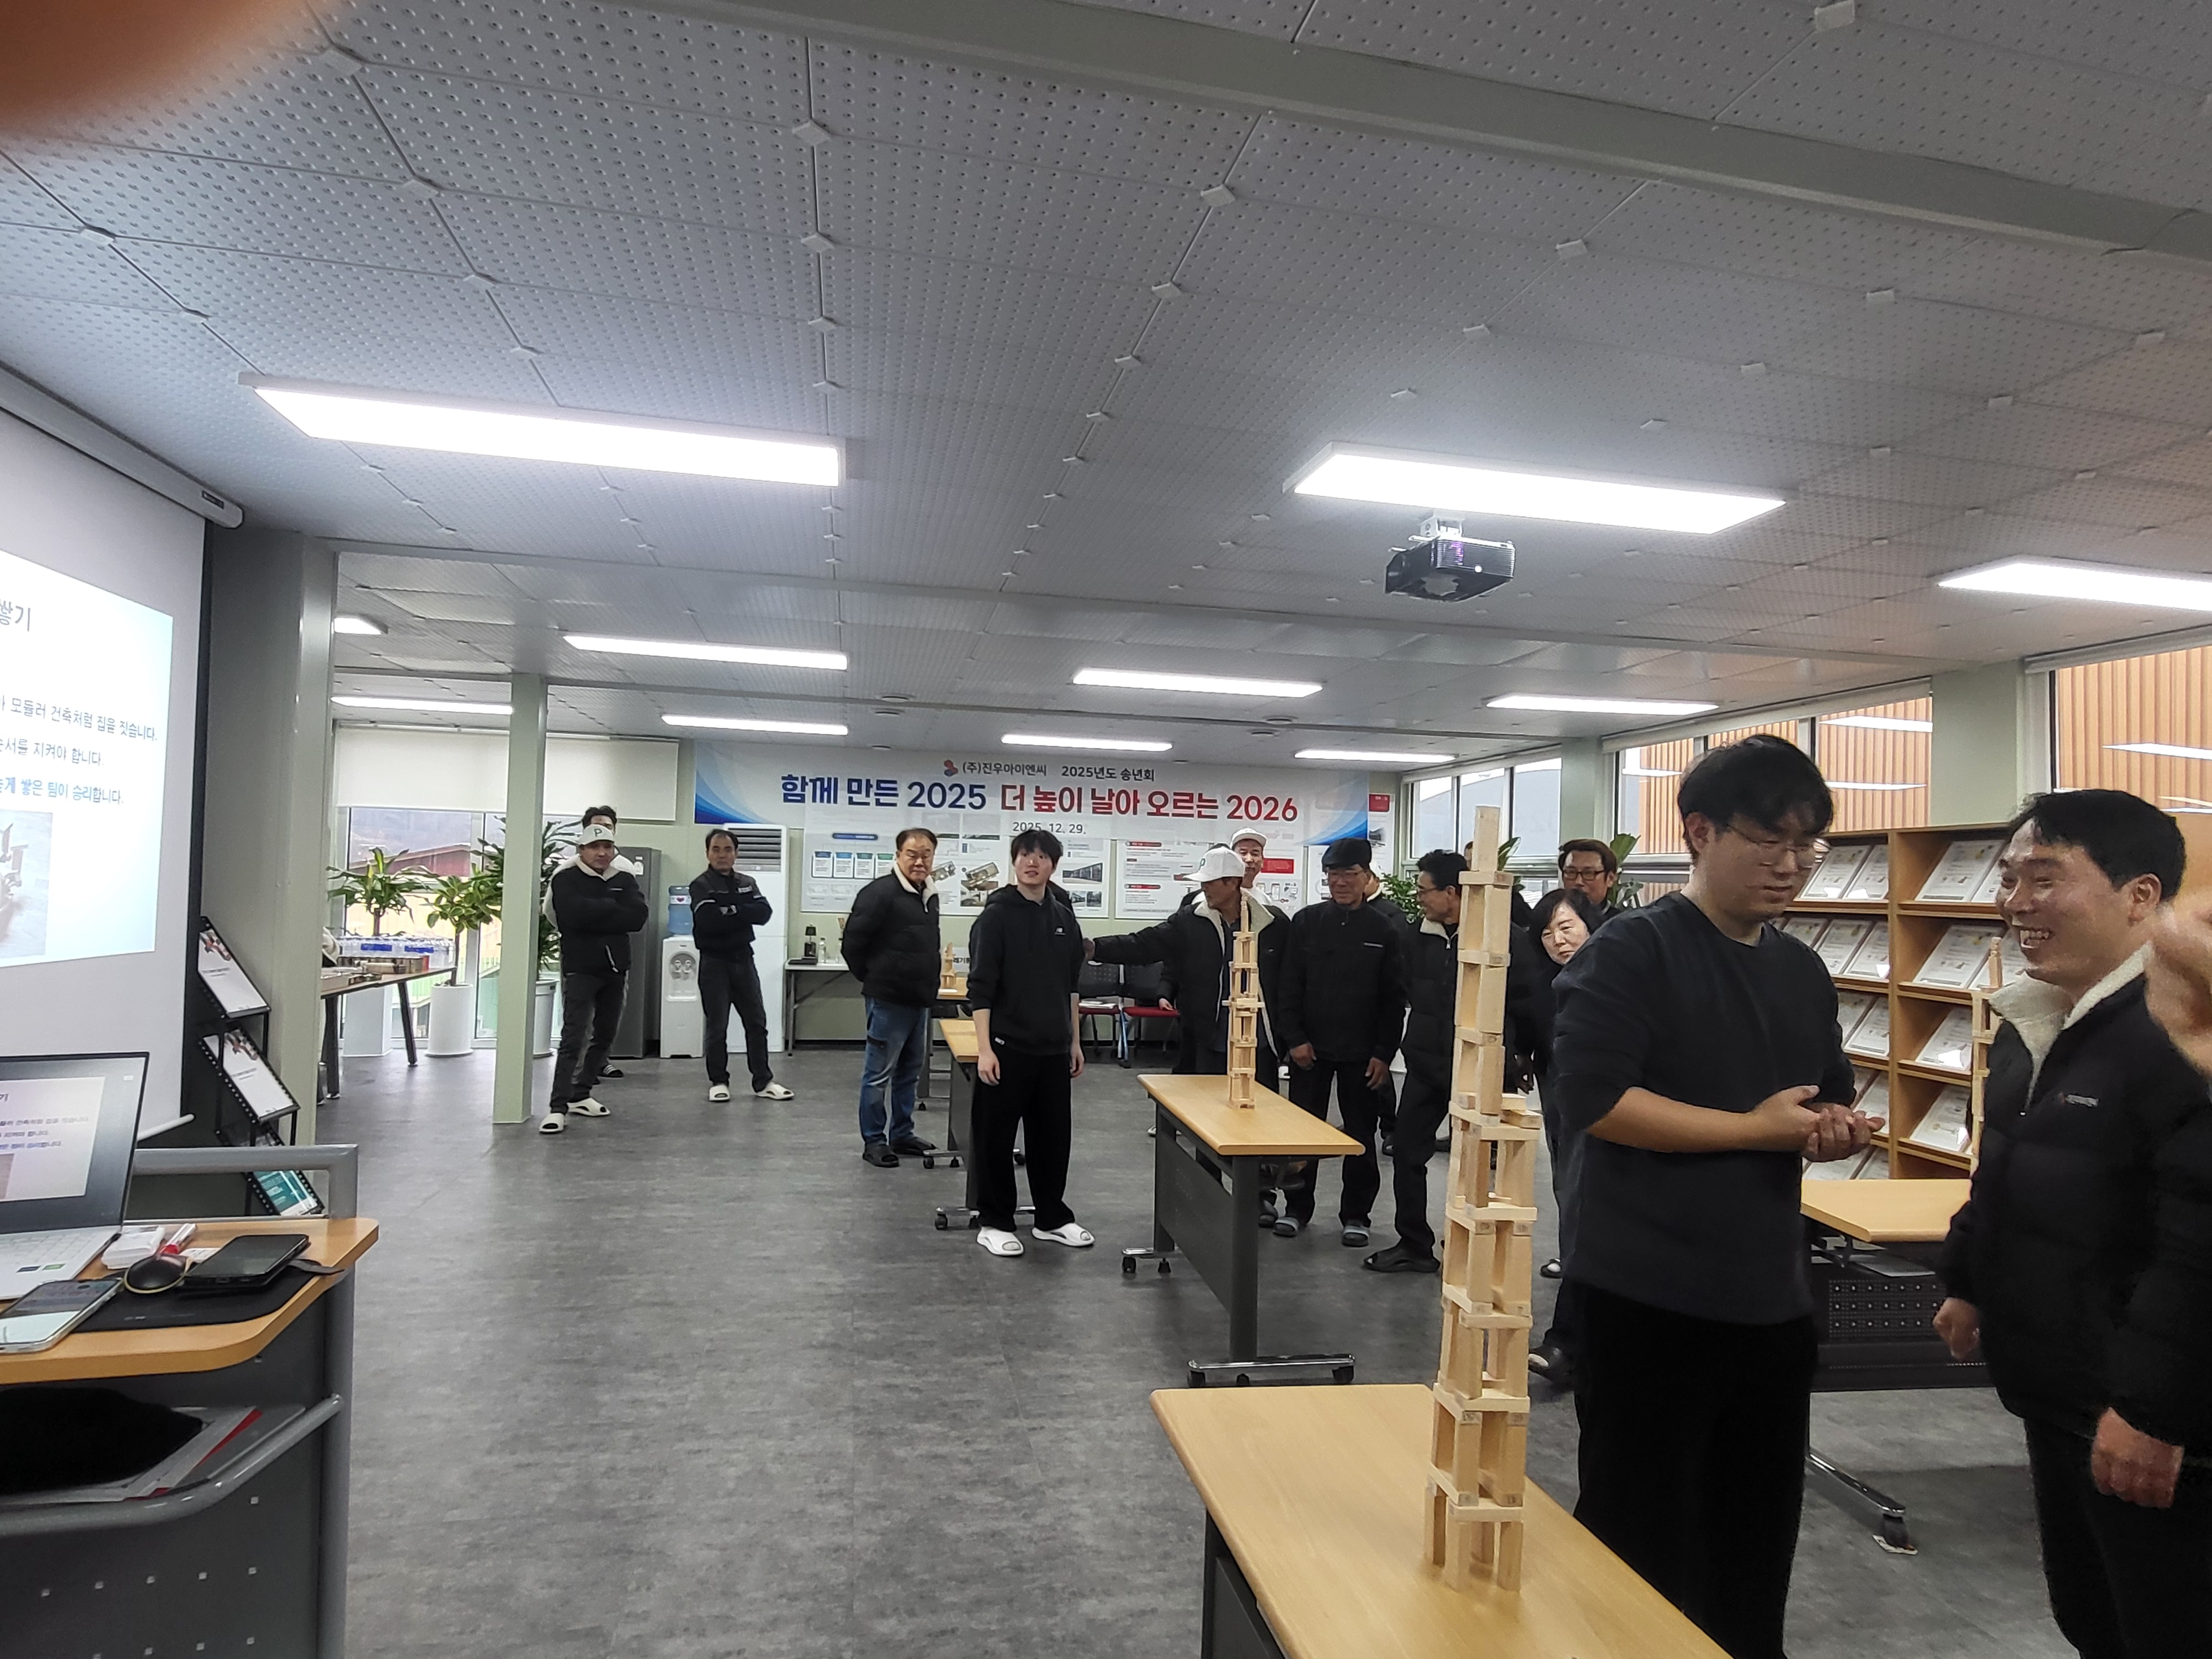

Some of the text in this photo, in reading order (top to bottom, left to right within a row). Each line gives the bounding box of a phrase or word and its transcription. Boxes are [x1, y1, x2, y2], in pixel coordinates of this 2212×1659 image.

[11, 697, 45, 719] 모듈러
[51, 706, 92, 728] 건축처럼
[97, 716, 116, 734] 집을
[119, 721, 157, 741] 짓습니다.
[33, 742, 66, 761] 지켜야
[72, 748, 104, 766] 합니다.
[962, 761, 1155, 781] (주)진우아이엔씨 2025년도 송년회
[48, 782, 68, 799] 팀이
[72, 785, 123, 805] 승리합니다.
[781, 774, 1298, 822] 함께 만든 2025 더 높이 날아 오르는 2026
[594, 828, 602, 837] P
[1048, 823, 1066, 833] 12.
[1069, 824, 1086, 834] 29.
